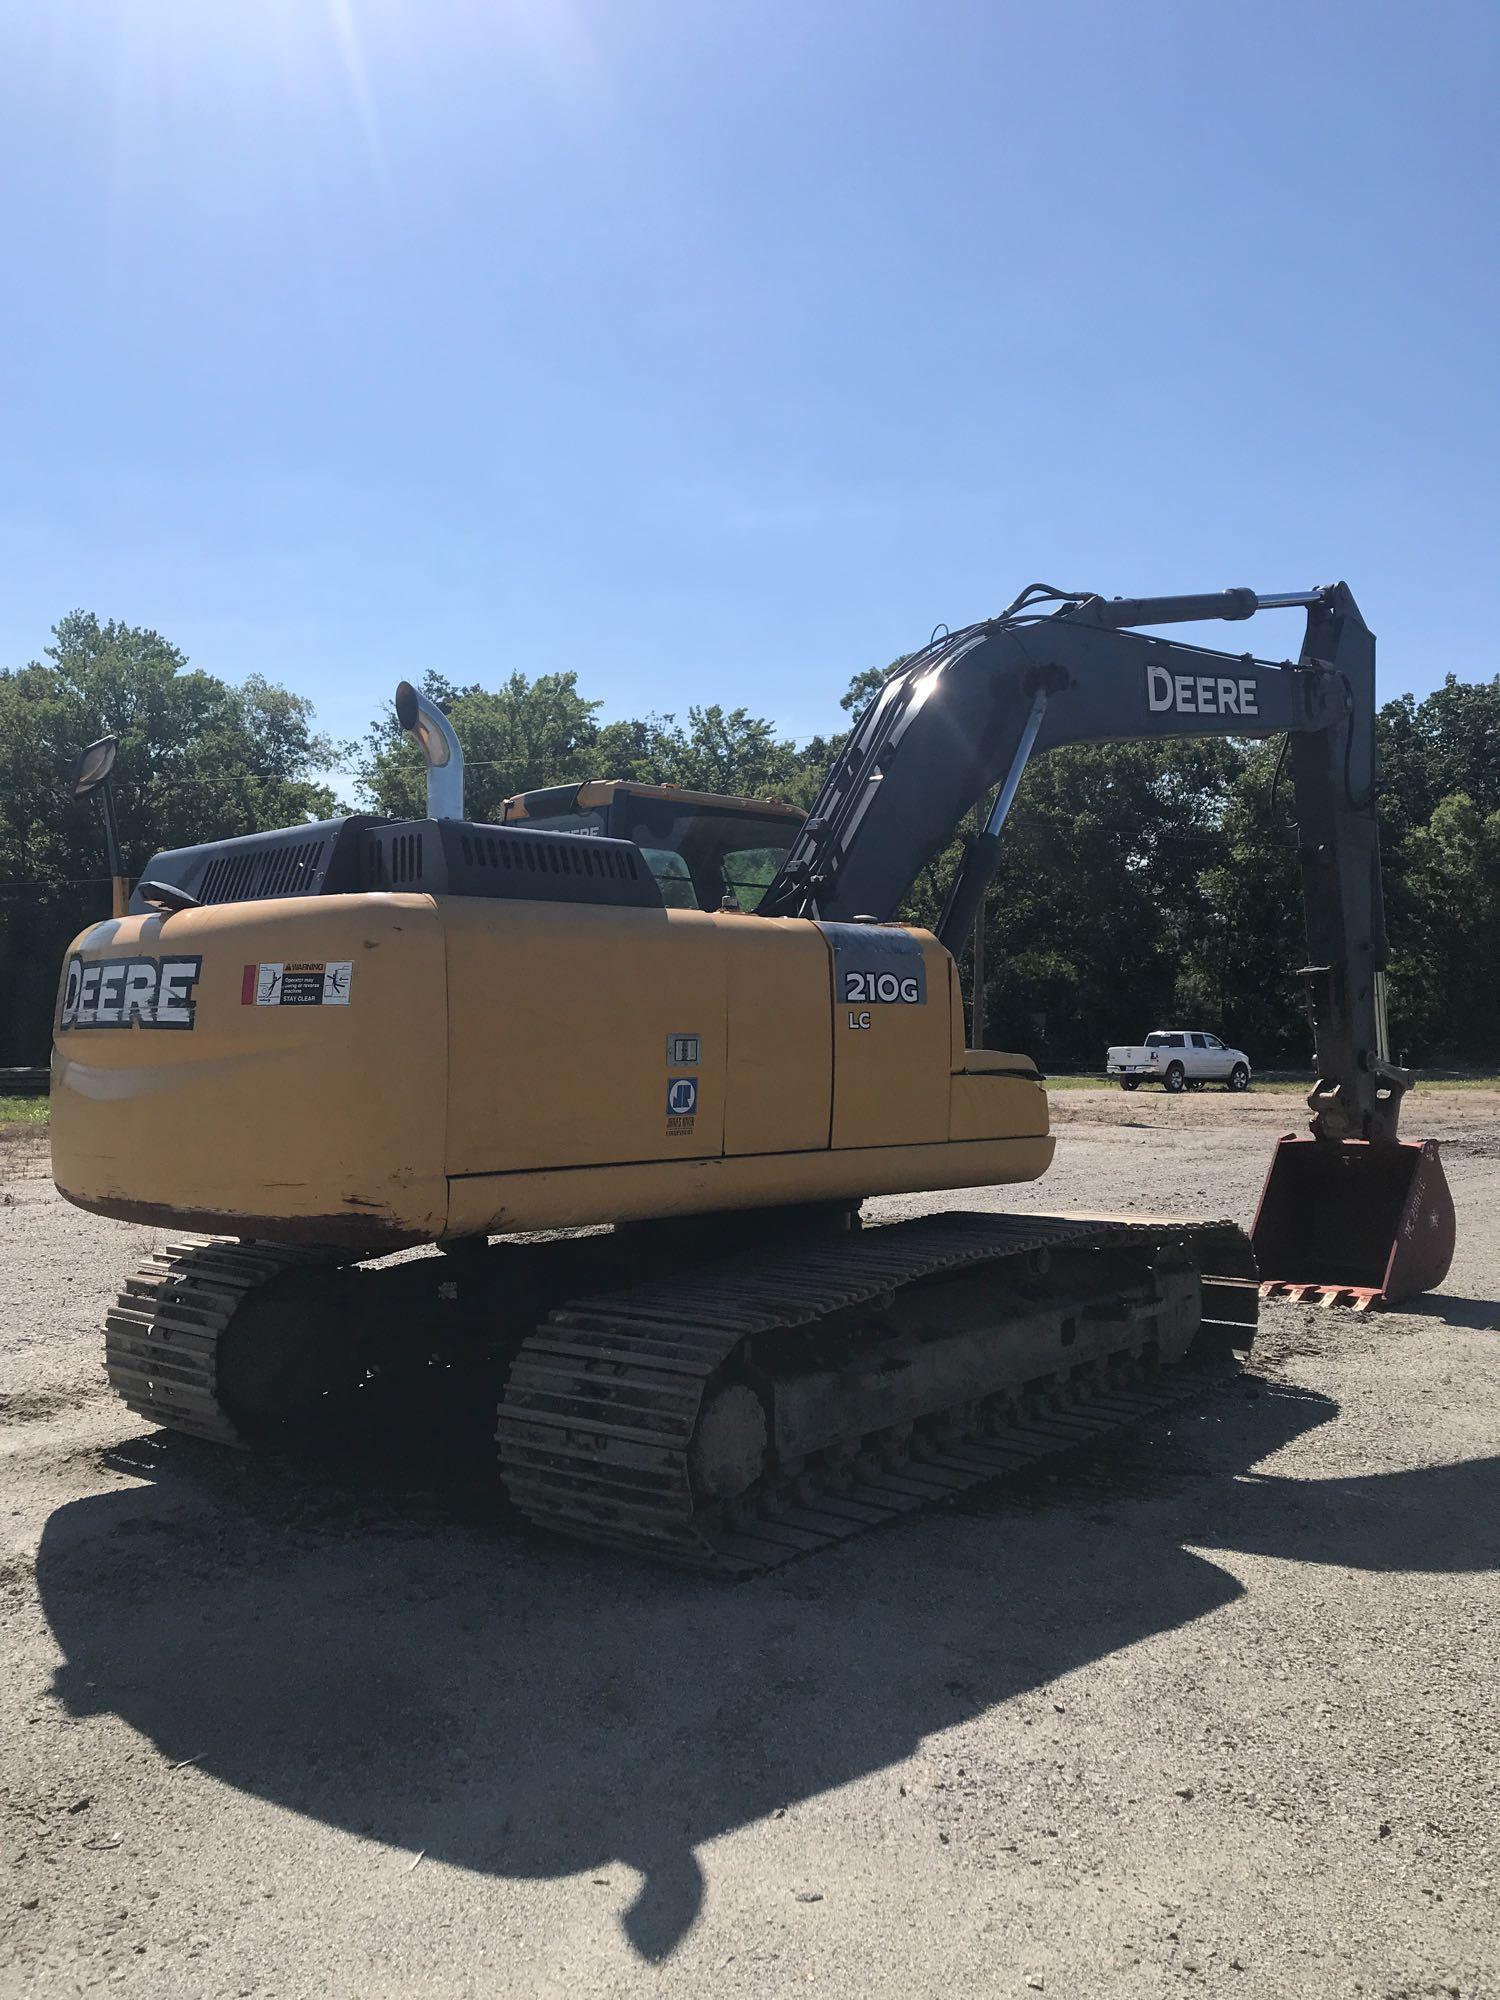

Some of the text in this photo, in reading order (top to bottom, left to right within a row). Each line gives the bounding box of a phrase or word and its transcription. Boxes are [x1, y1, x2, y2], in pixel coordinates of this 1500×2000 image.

[1147, 665, 1258, 714] DEERE
[291, 963, 324, 971] WARNING
[61, 959, 198, 1025] DEERE
[846, 973, 918, 1002] 210G
[849, 1012, 870, 1029] LC
